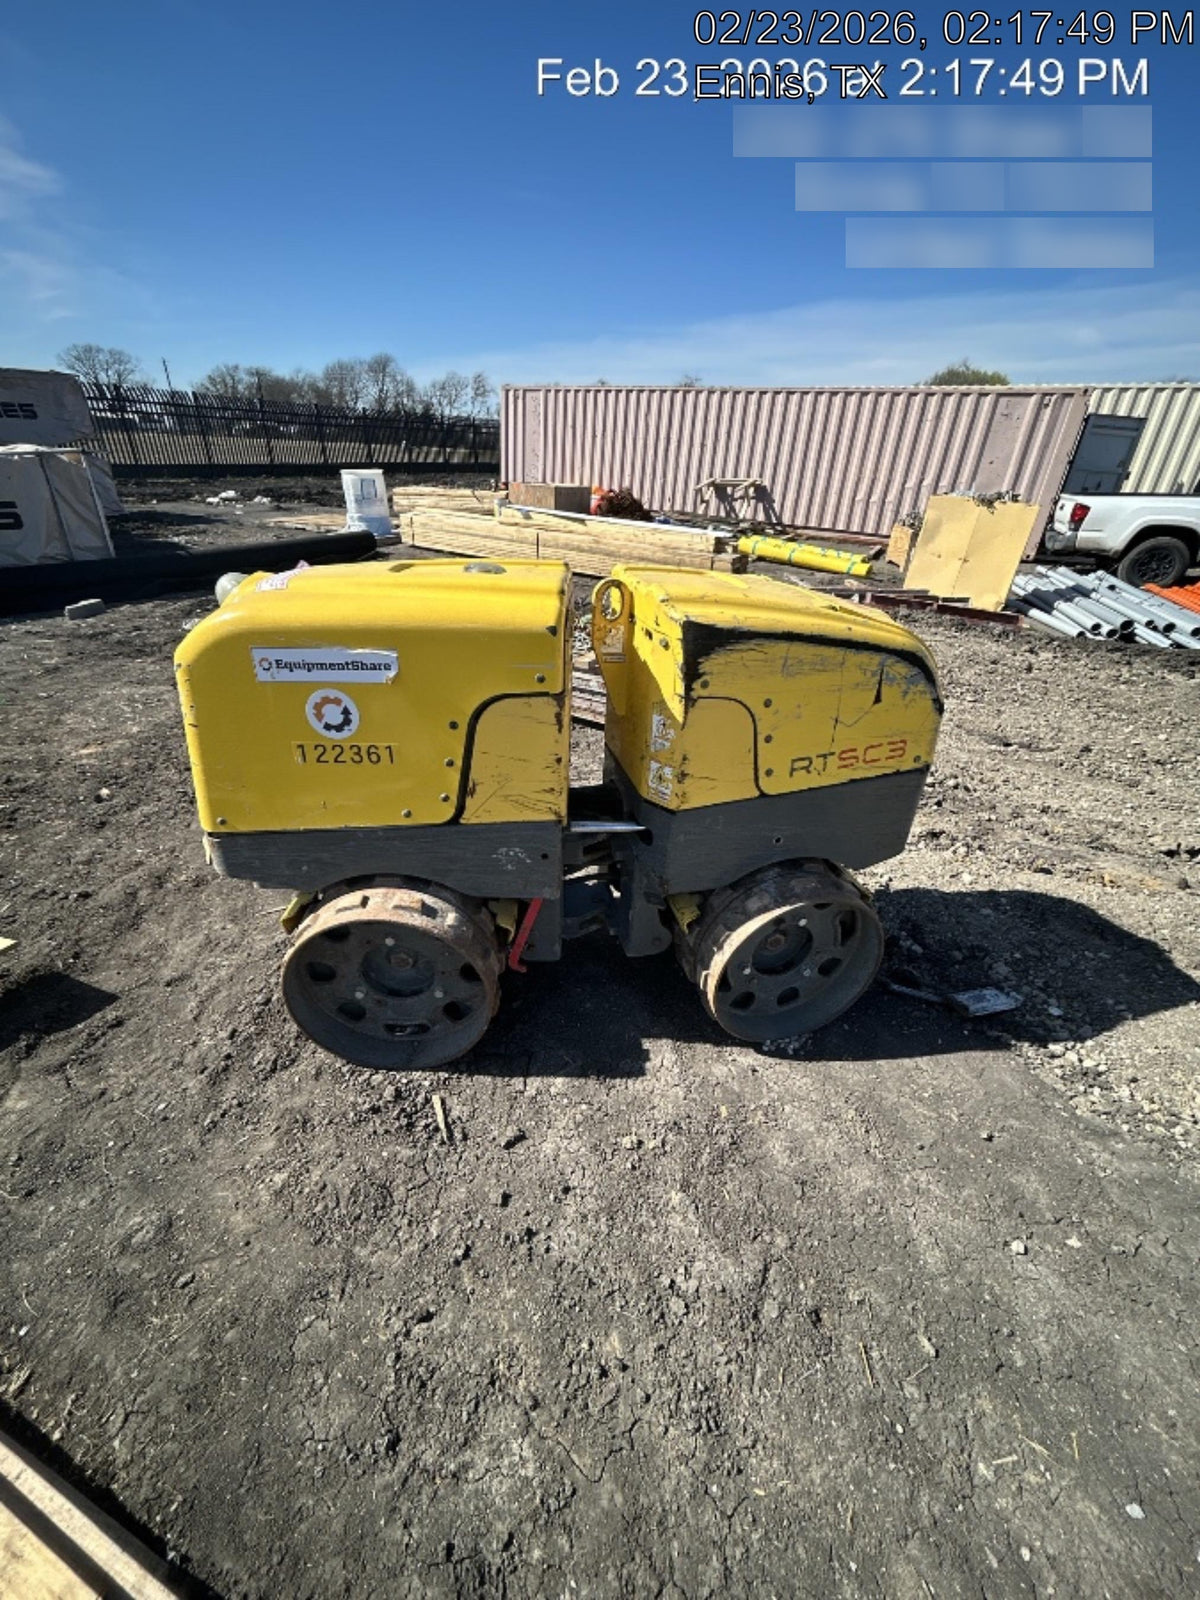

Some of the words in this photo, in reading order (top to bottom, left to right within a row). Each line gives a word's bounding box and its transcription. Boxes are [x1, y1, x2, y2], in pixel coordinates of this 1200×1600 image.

[0, 401, 39, 420] ES
[274, 658, 392, 673] EquipmentShare
[296, 743, 395, 765] 122361
[789, 739, 908, 778] RTSC3
